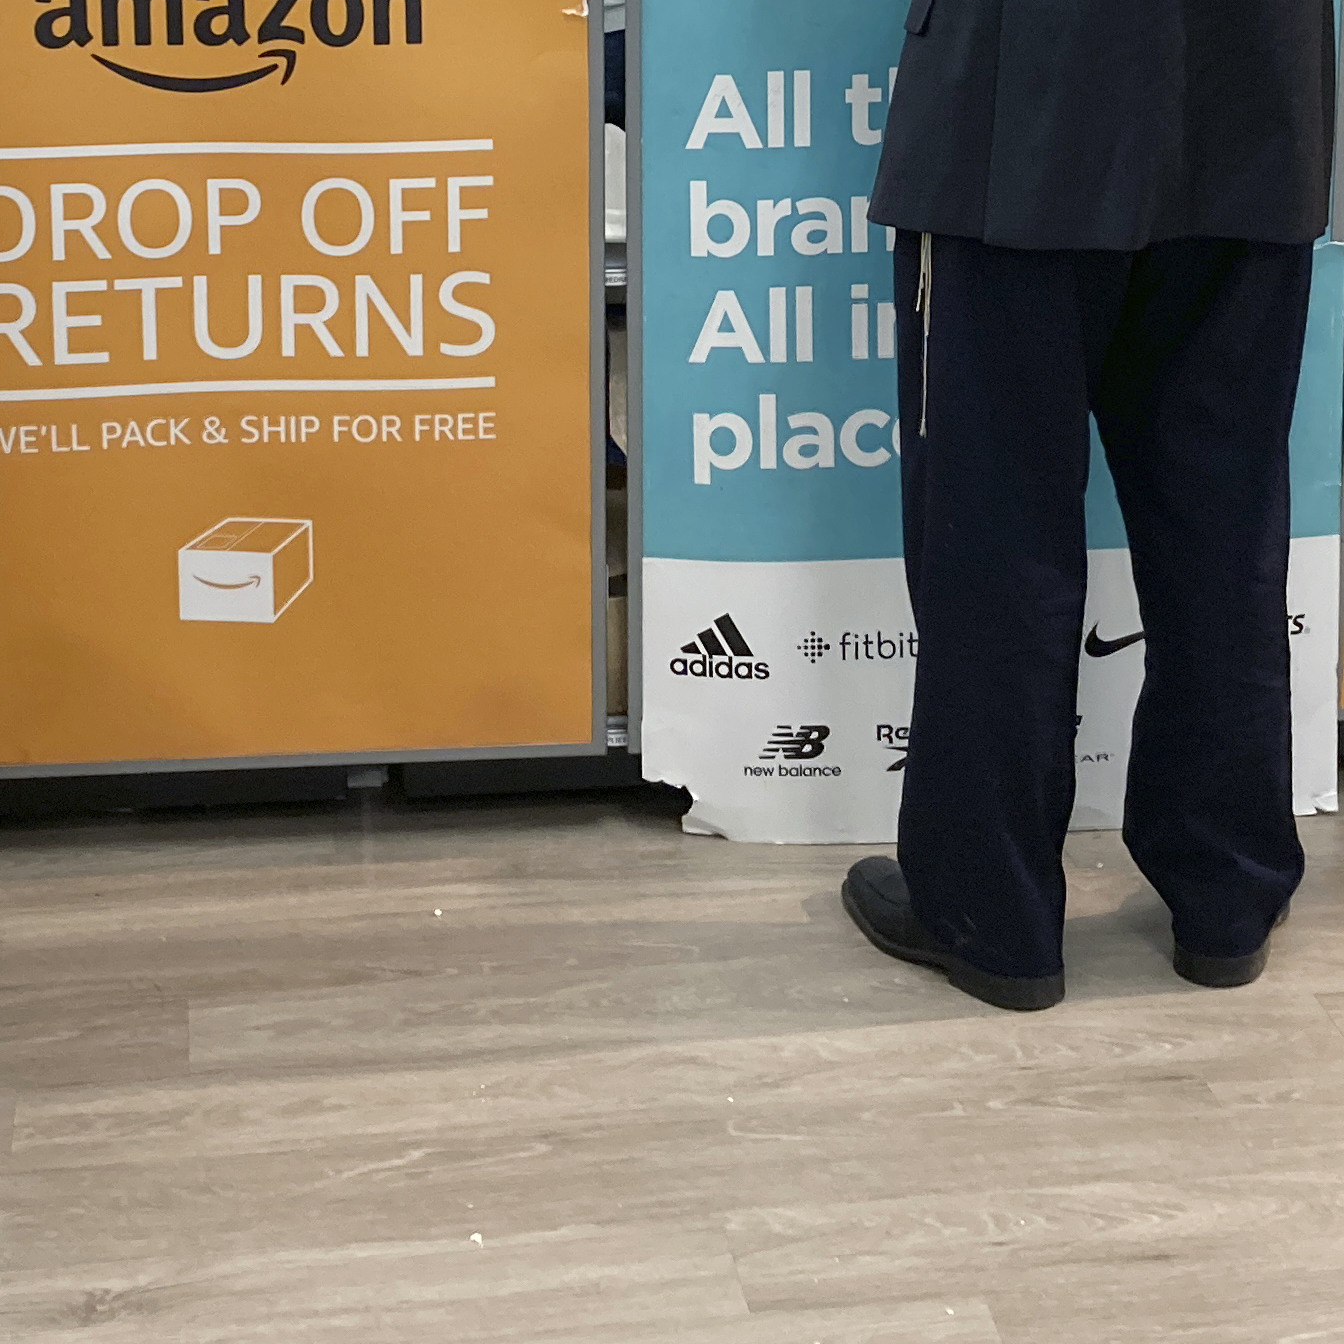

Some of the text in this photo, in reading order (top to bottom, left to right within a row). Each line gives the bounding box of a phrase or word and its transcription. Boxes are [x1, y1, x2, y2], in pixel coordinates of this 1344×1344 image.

[685, 67, 893, 150] All t
[301, 175, 494, 256] OFF
[689, 180, 896, 258] bran
[688, 286, 813, 364] All
[102, 418, 191, 450] PACK
[202, 416, 229, 444] &
[240, 415, 320, 443] SHIP
[333, 415, 401, 443] FOR
[414, 412, 496, 442] FREE
[692, 393, 902, 486] plac
[669, 654, 770, 680] adidas
[839, 631, 919, 660] fitbit
[744, 765, 842, 777] new balance
